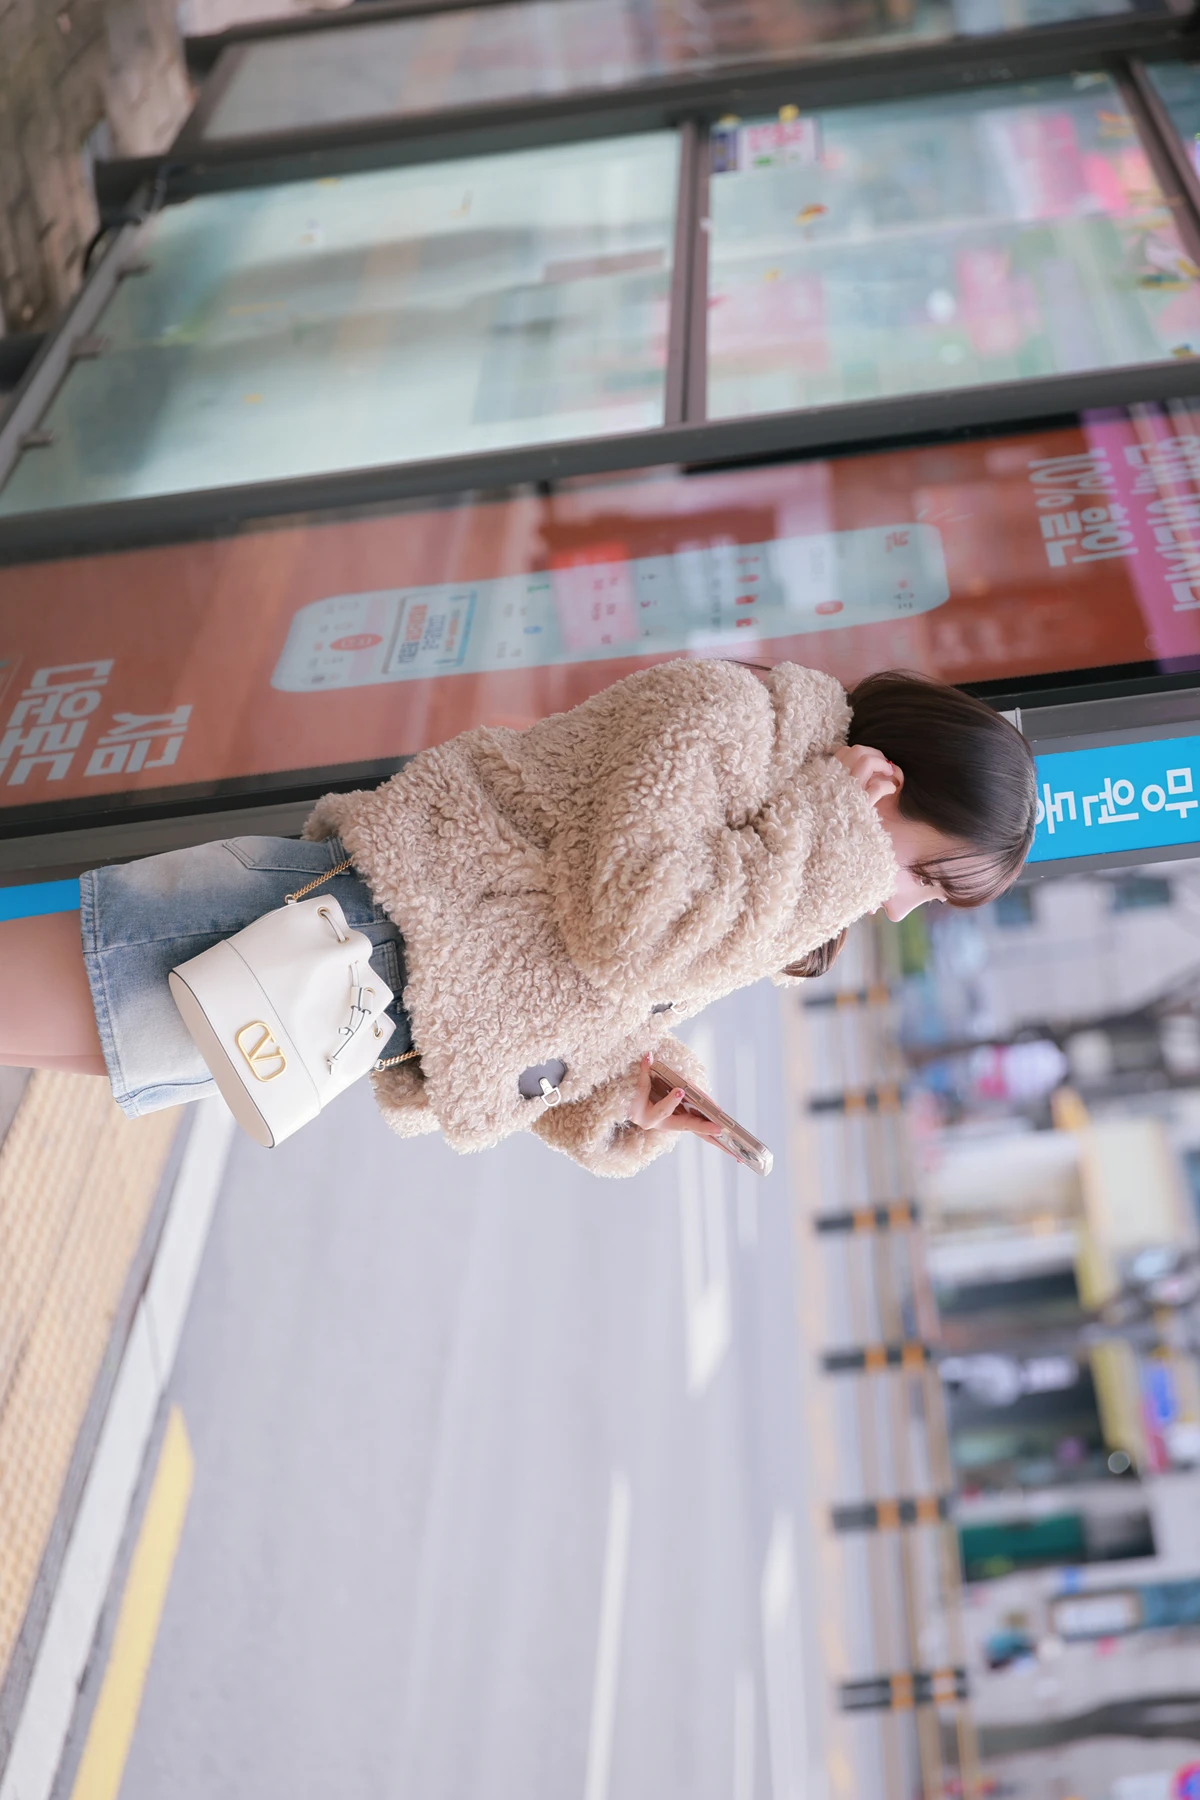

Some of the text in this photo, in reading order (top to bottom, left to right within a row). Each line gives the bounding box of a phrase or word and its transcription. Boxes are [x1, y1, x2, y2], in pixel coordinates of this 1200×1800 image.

[1027, 447, 1138, 568] 10% 할인
[82, 704, 194, 777] 지금
